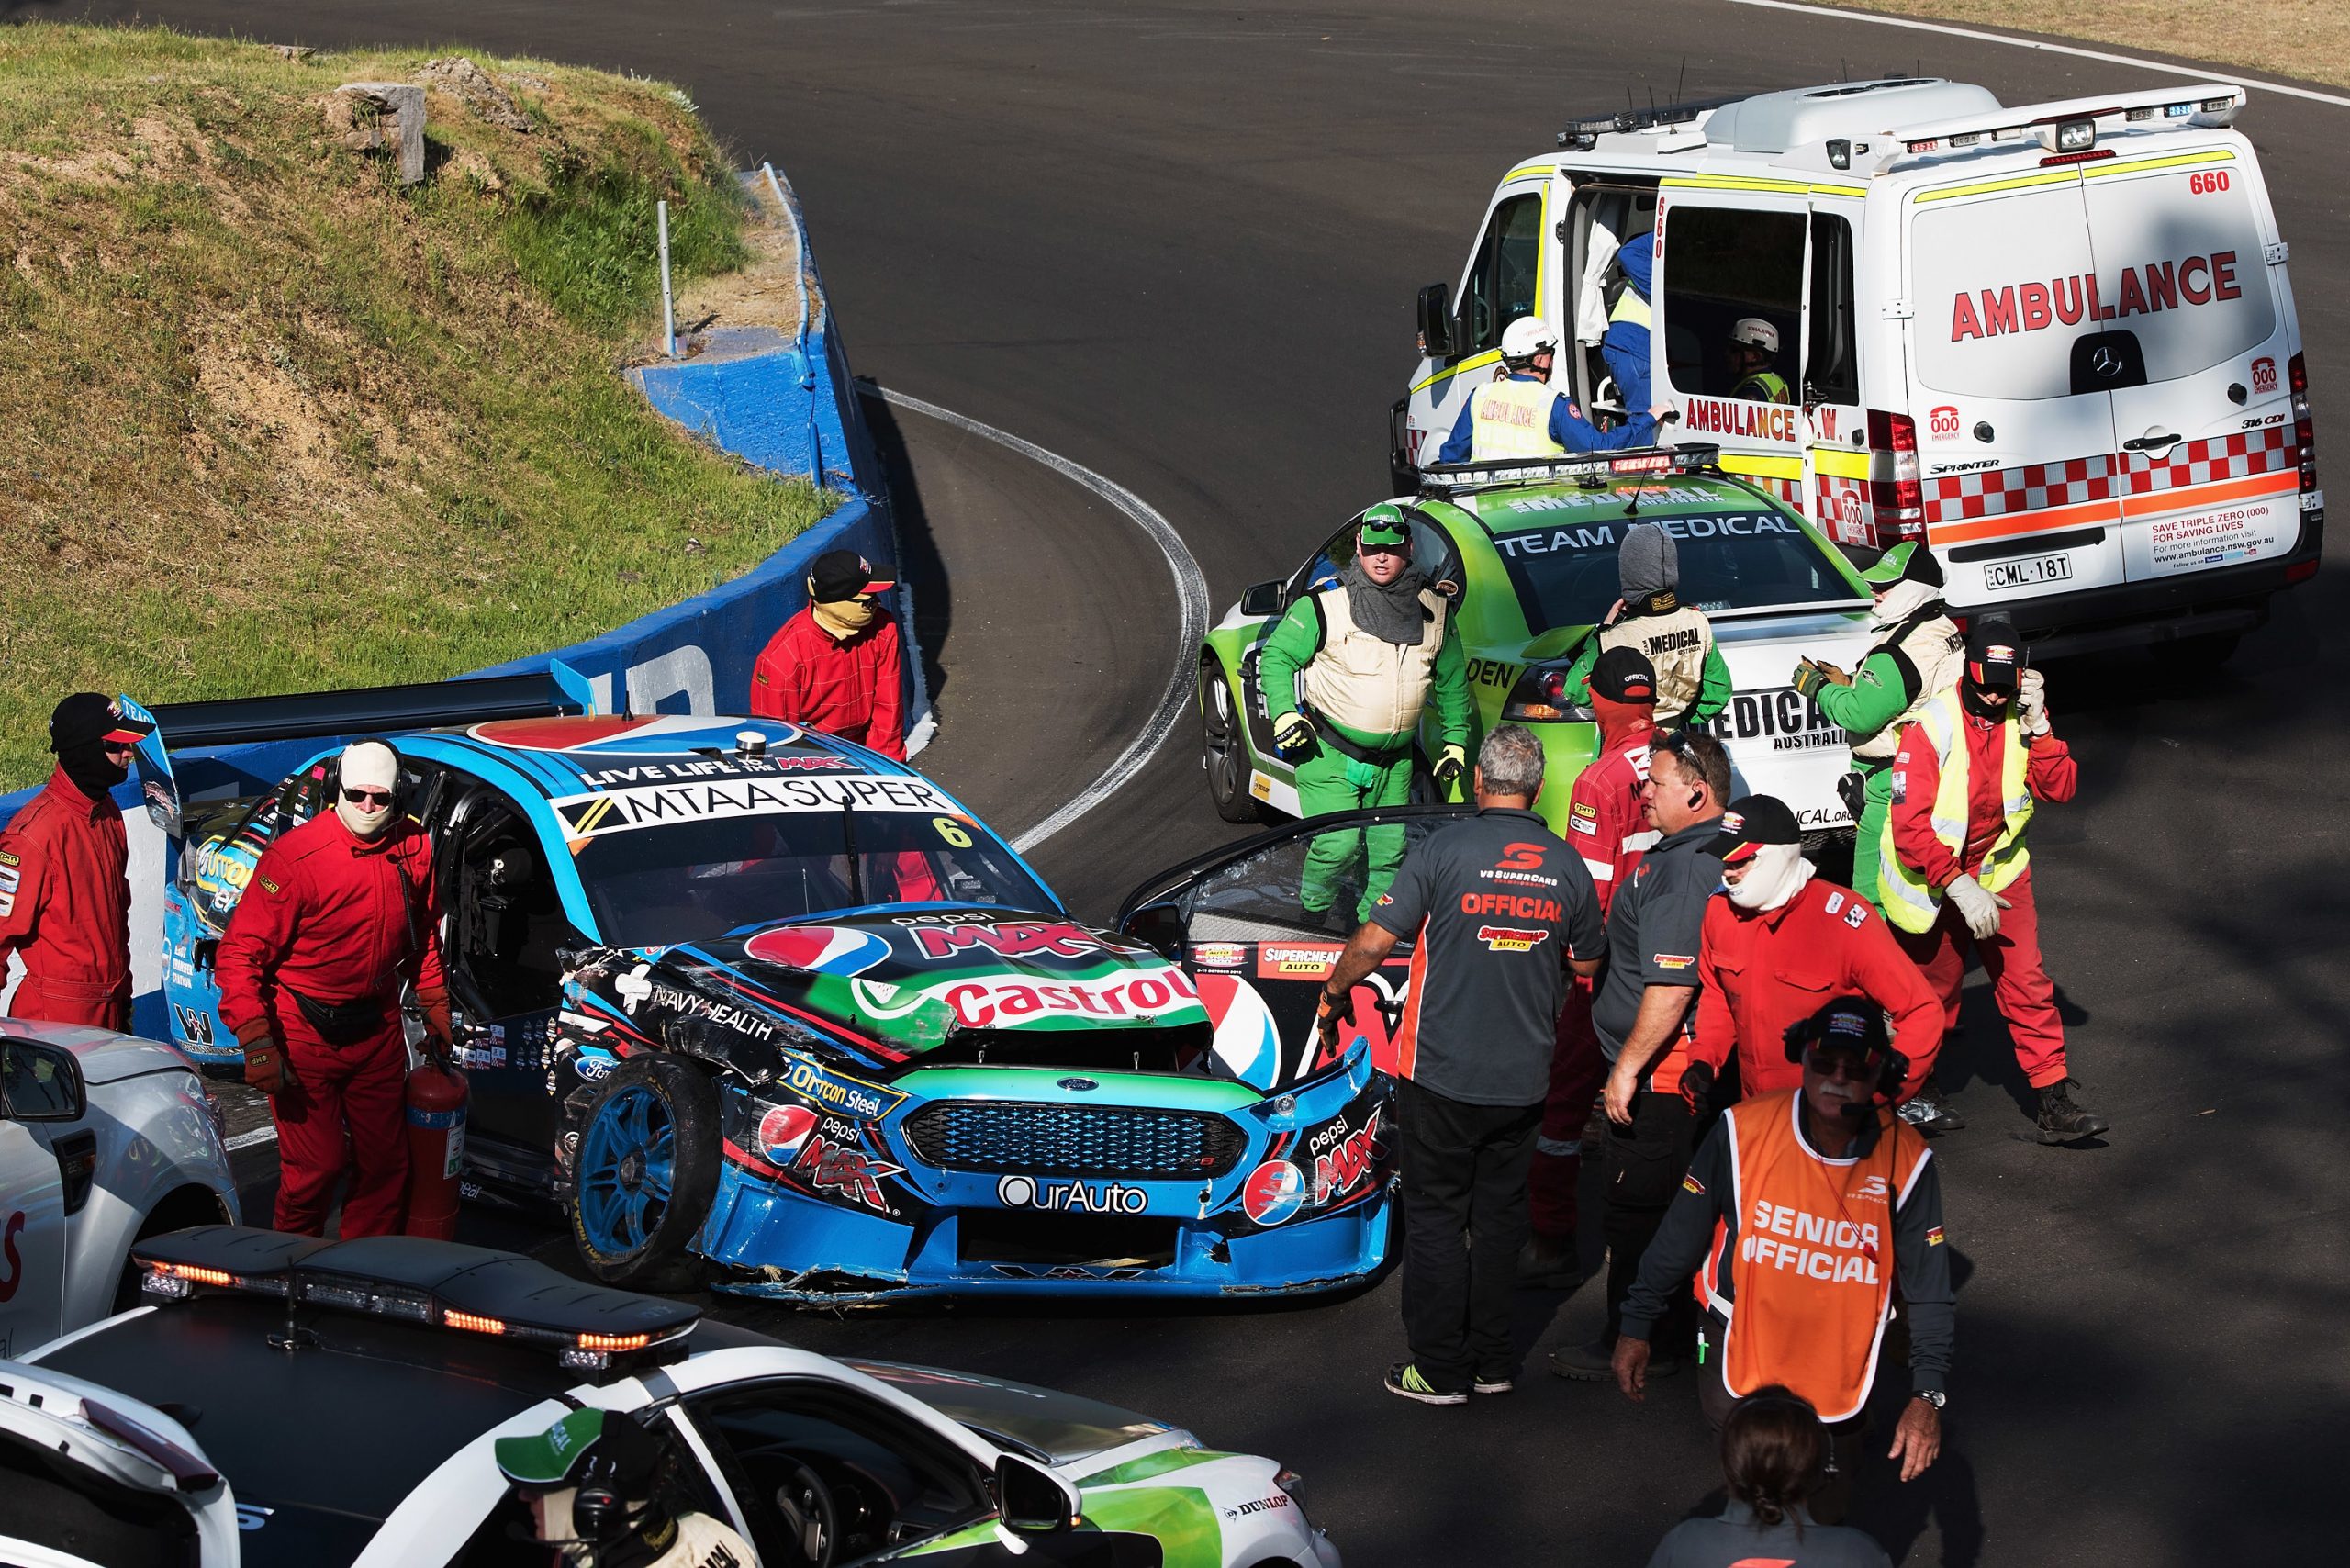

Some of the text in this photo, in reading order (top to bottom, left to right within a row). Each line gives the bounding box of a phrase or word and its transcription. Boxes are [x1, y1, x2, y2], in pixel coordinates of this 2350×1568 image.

[2190, 171, 2230, 195] 660
[1656, 196, 1665, 259] 660
[1952, 251, 2242, 342] AMBULANCE
[2253, 367, 2276, 386] 000
[1480, 398, 1539, 428] AMBULANCE
[1686, 398, 1796, 442] AMBULANCE
[1931, 417, 1959, 432] 000
[2241, 413, 2285, 429] 316 CDI
[1931, 432, 1960, 442] EMERGENCY
[1930, 459, 2000, 474] SPRINTER
[1843, 505, 1863, 524] 000
[2153, 506, 2269, 534] SAVE TRIPLE ZERO (000)
[1494, 526, 1614, 557] TEAM
[2153, 521, 2244, 544] FOR SAVING LIVES
[2154, 530, 2257, 554] For more information visit
[2154, 536, 2274, 563] www.ambulance.nsw.gov.au
[1648, 627, 1701, 655] MEDICAL
[1624, 673, 1649, 682] OFFICIAL
[1774, 729, 1848, 750] AUSTRALI
[581, 756, 856, 786] LIVE LIFE THE MAX
[740, 758, 764, 767] TO
[626, 778, 948, 823] MTAA SUPER
[1576, 804, 1595, 815] rpm
[933, 817, 973, 848] 6
[1480, 870, 1493, 879] V8
[891, 912, 995, 927] pepsi
[1461, 893, 1562, 924] OFFICIAL
[909, 922, 1115, 960] MAX
[1478, 927, 1548, 944] SUPERCHEAP
[1497, 940, 1527, 948] AUTO
[944, 969, 1199, 1027] Castrol
[654, 986, 774, 1041] NAVY HEALTH
[1065, 1078, 1091, 1090] Ford
[848, 1090, 881, 1117] Steel
[822, 1116, 862, 1143] pepsi
[1310, 1114, 1348, 1150] pepsi
[1315, 1107, 1390, 1205] MAX
[795, 1135, 909, 1214] MAX
[999, 1175, 1147, 1215] OurAuto
[1754, 1199, 1879, 1252] SENIOR
[1742, 1234, 1879, 1285] OFFICIAL
[1237, 1495, 1288, 1515] DUNLOP
